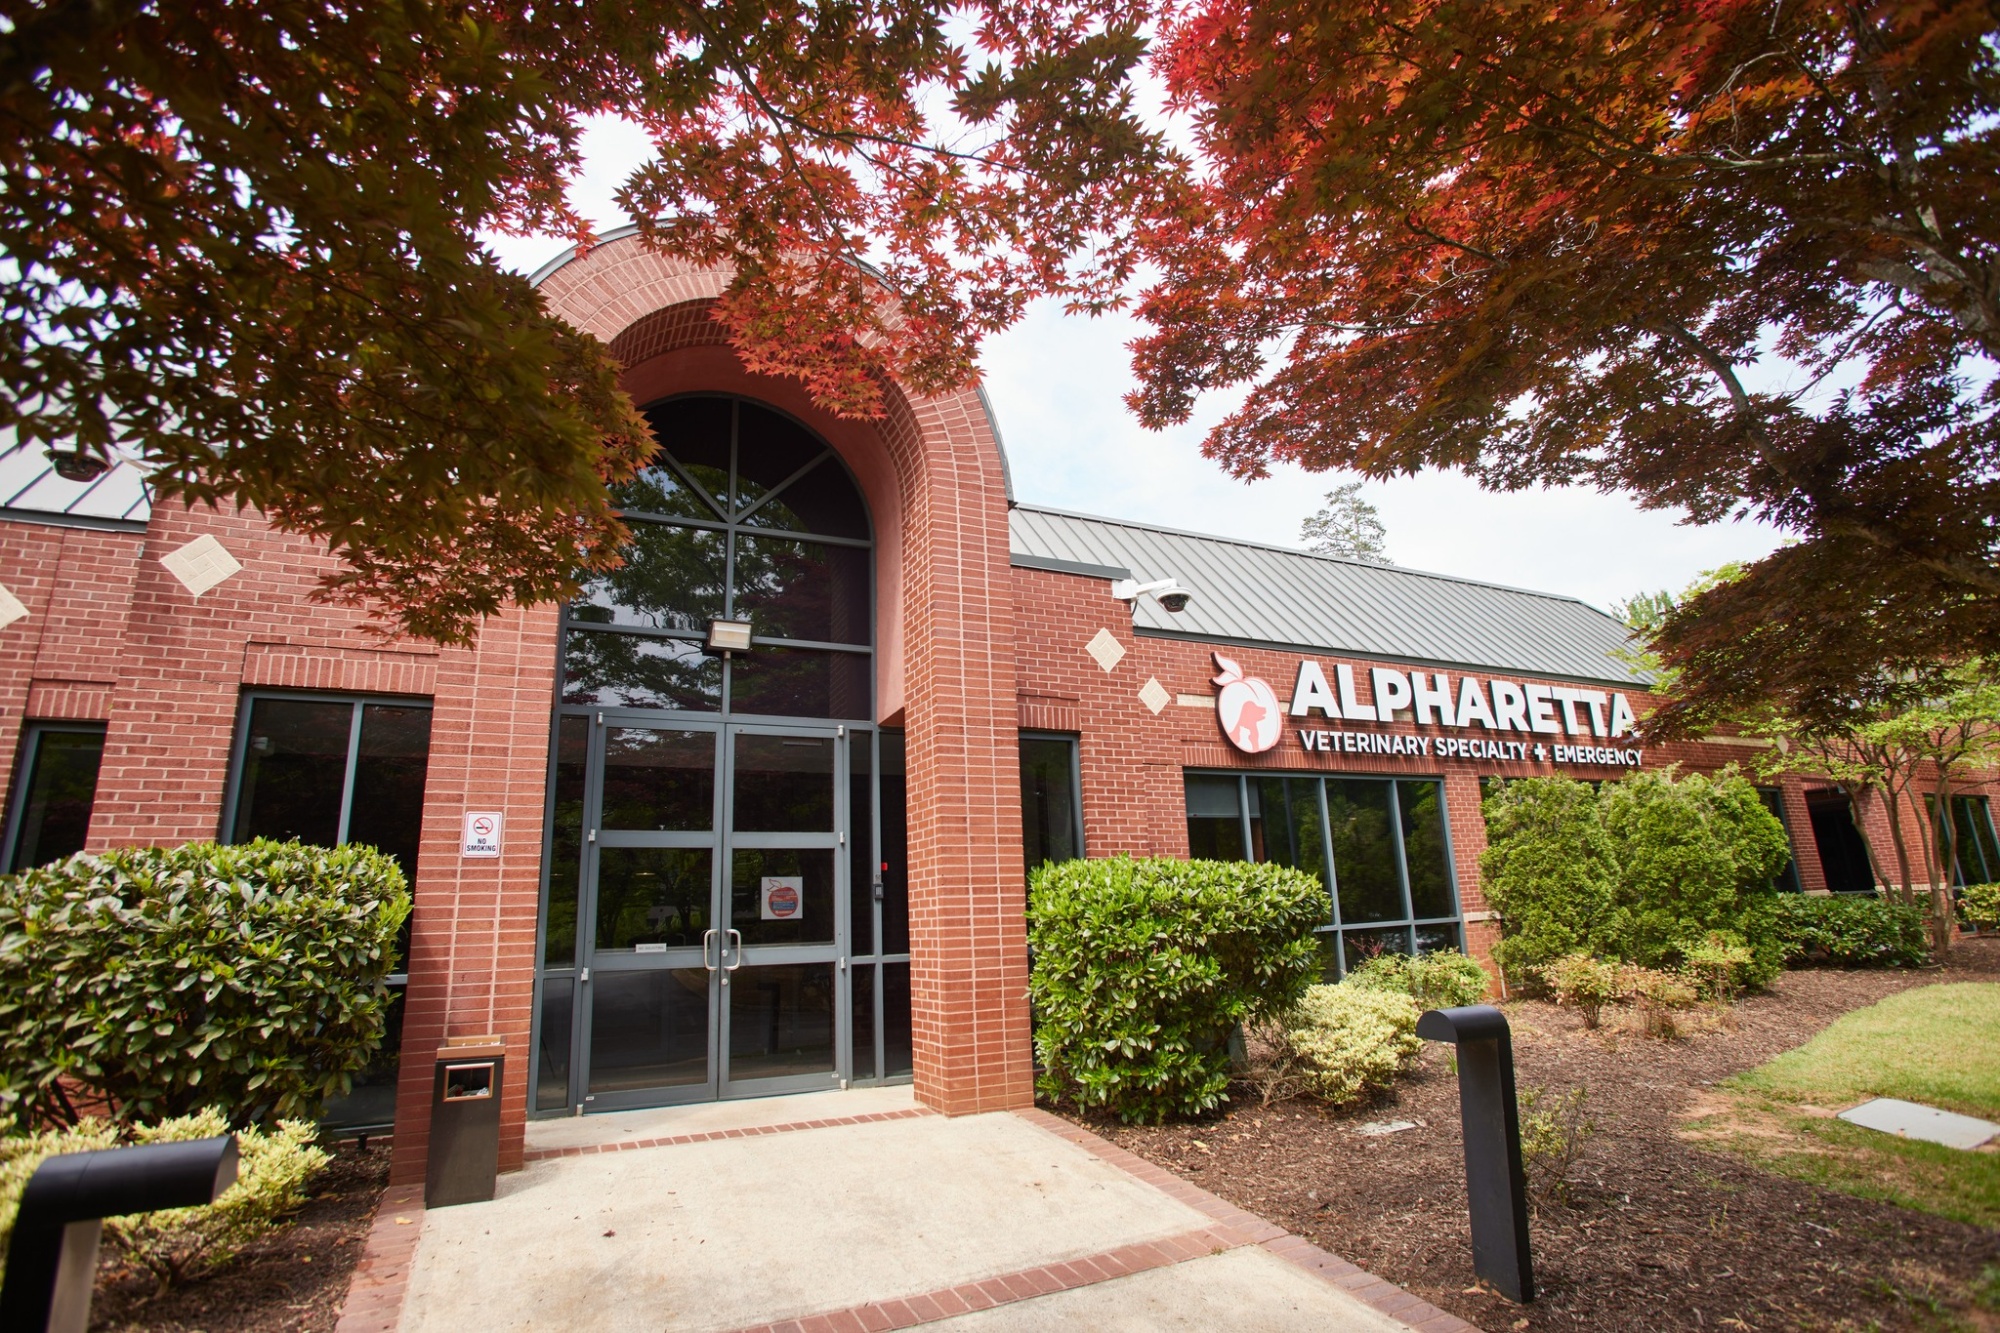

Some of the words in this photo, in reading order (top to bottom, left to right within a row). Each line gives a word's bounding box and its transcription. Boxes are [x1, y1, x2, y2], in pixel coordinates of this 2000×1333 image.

[1290, 660, 1641, 738] ALPHARETTA
[1298, 730, 1430, 757] VETERINARY
[1435, 737, 1527, 761] SPECIALTY
[1555, 745, 1643, 766] EMERGENCY
